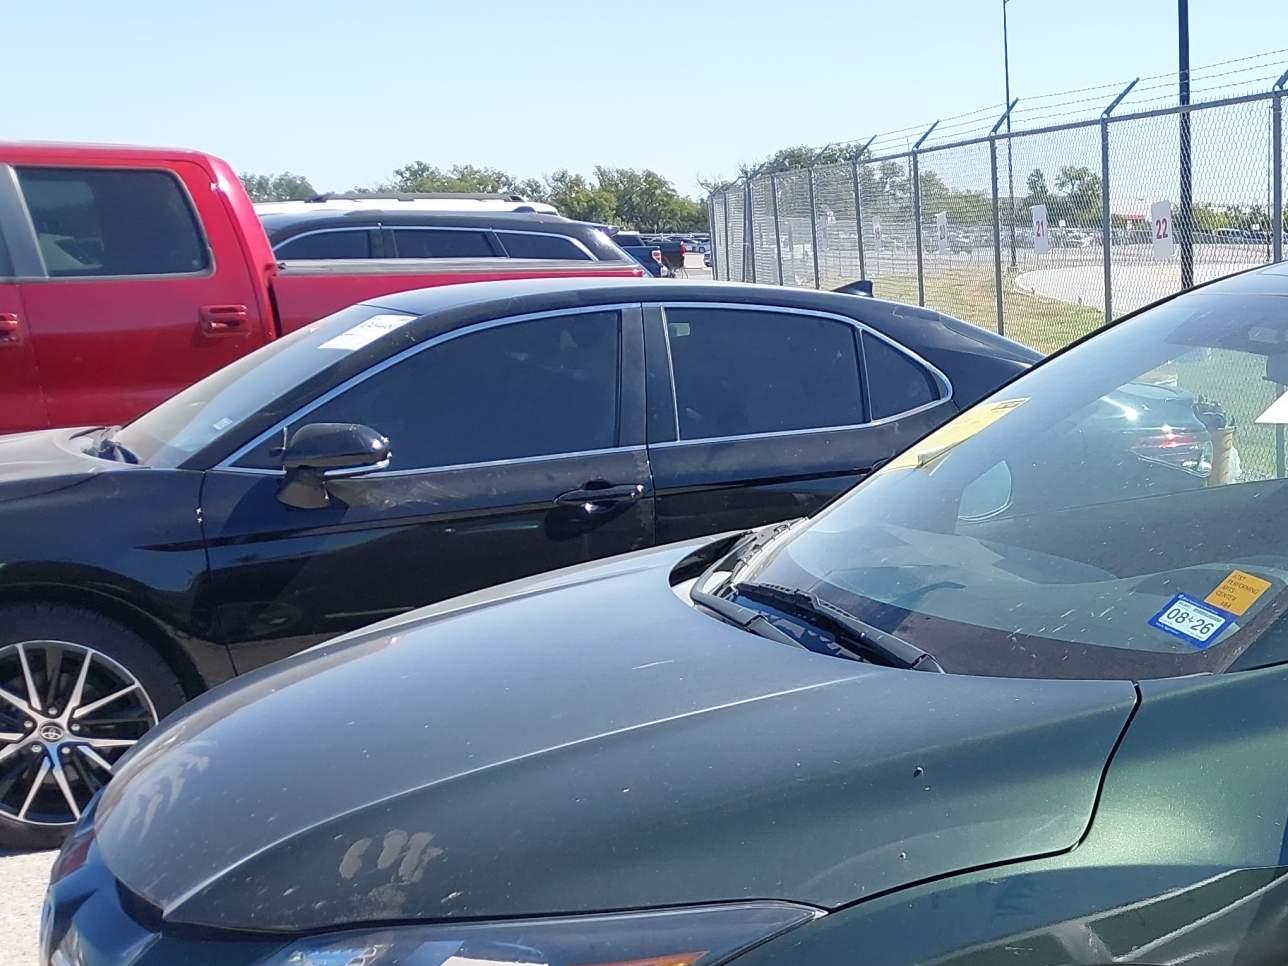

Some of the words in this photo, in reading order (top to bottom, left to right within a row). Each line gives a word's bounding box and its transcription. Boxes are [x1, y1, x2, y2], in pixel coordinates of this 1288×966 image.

[1035, 220, 1045, 238] 21
[1155, 217, 1169, 240] 22
[1166, 607, 1190, 624] 08
[1190, 618, 1215, 635] 26
